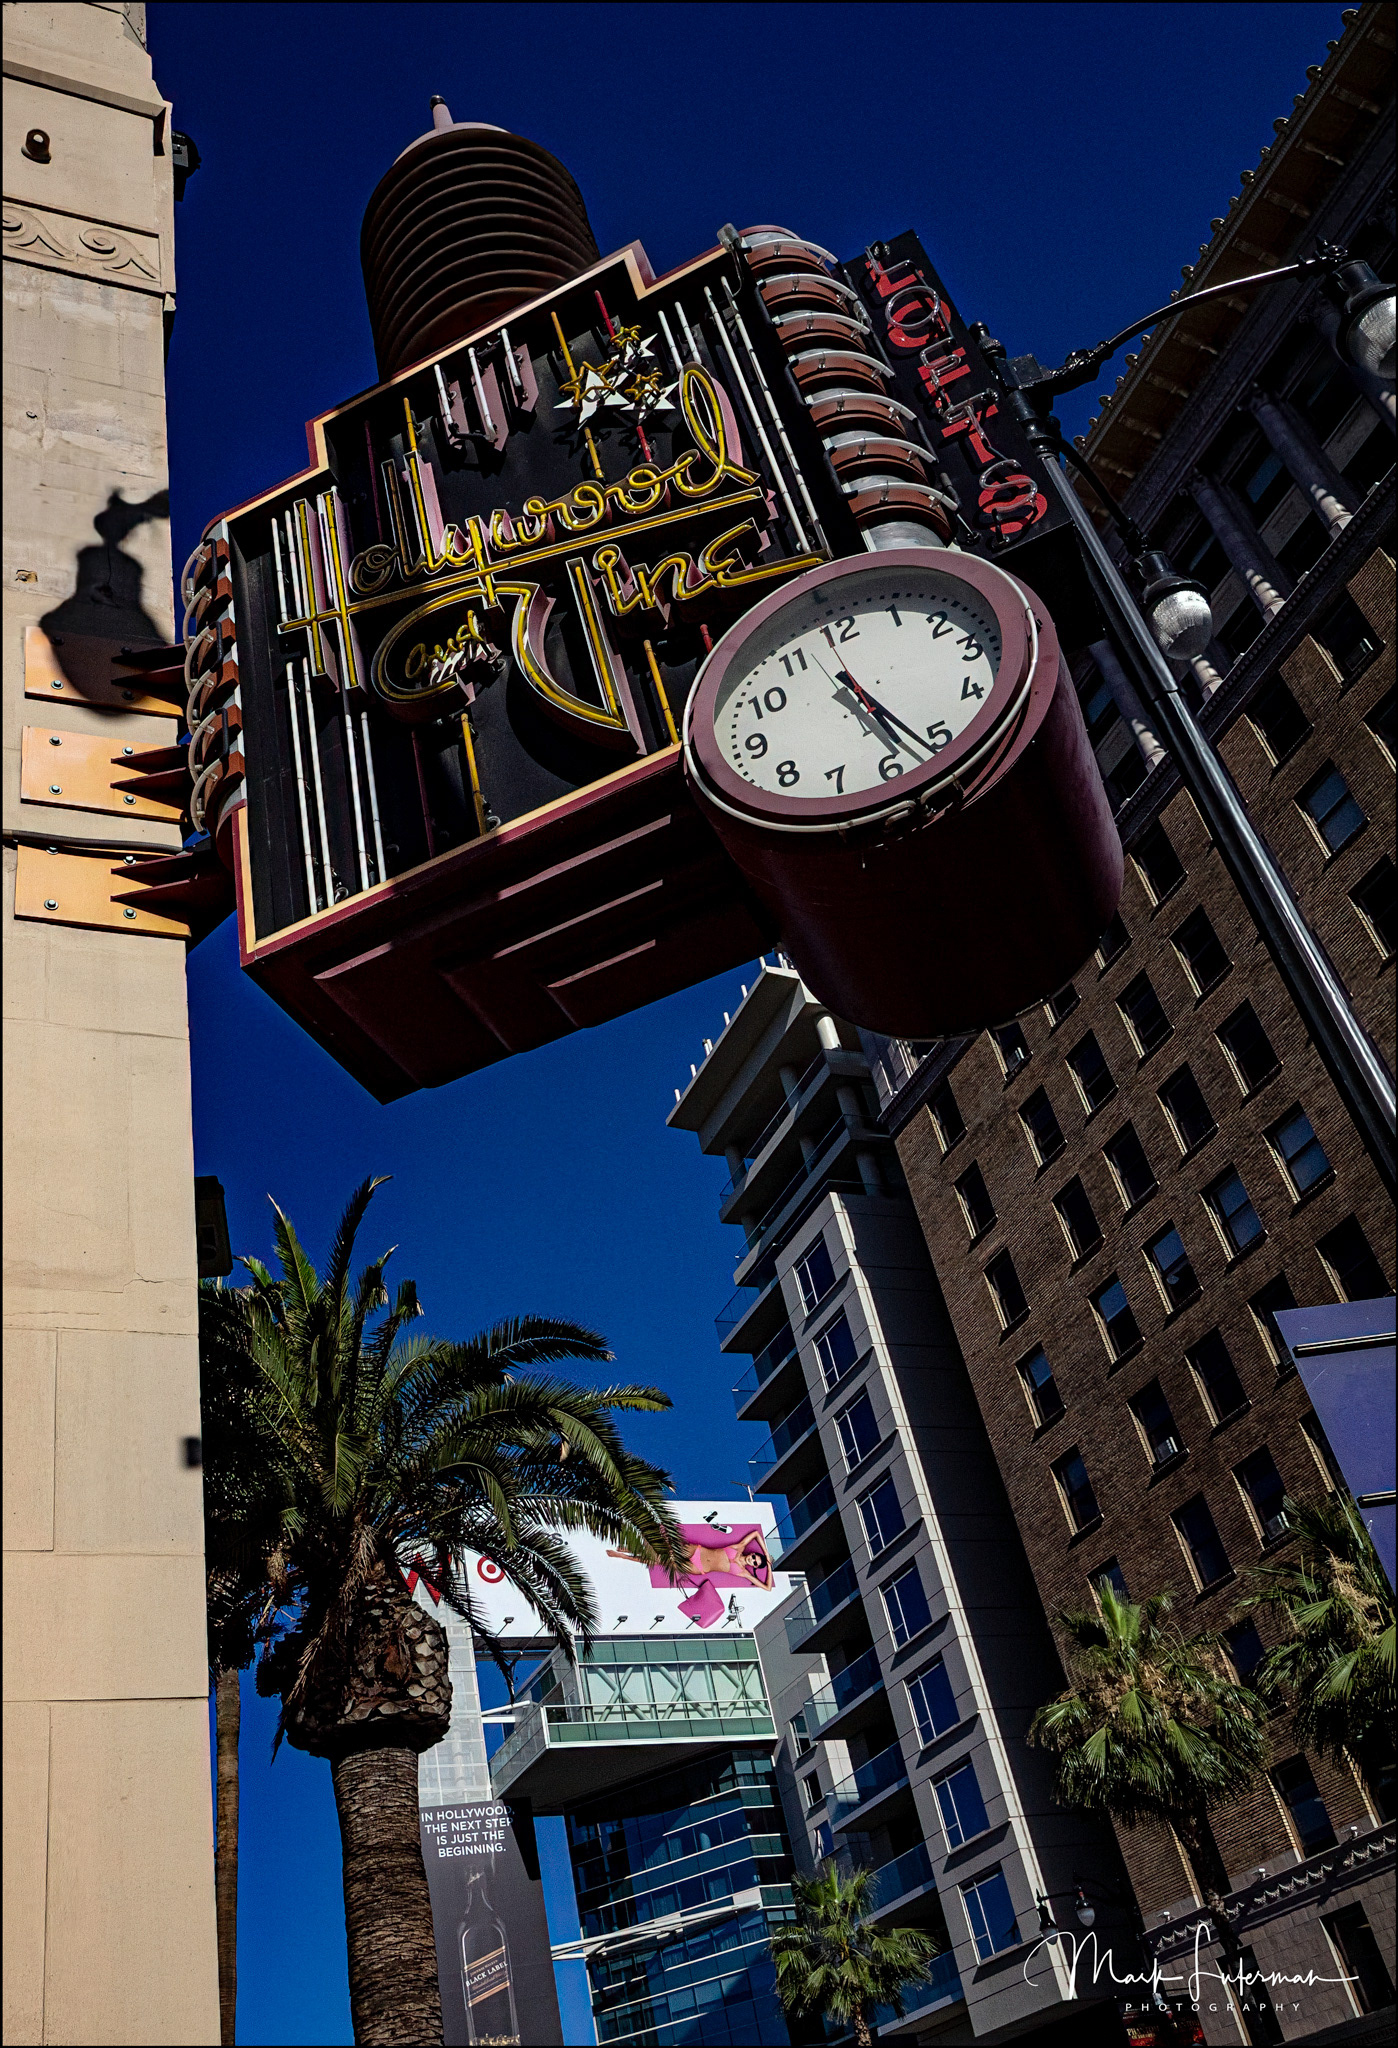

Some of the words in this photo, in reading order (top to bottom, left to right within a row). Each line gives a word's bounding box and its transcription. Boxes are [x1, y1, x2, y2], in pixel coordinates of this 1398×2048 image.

[278, 363, 760, 690] Hollywood
[372, 517, 828, 732] Vine
[884, 604, 904, 627] 1
[926, 611, 953, 639] 2
[820, 615, 860, 649] 12
[404, 610, 499, 687] and
[956, 633, 984, 662] 3
[778, 647, 808, 677] 11
[960, 676, 985, 701] 4
[748, 686, 787, 720] 10
[745, 733, 768, 759] 9
[926, 720, 953, 750] 5
[775, 760, 800, 788] 8
[824, 765, 847, 794] 7
[878, 753, 904, 782] 6
[421, 1812, 433, 1822] IN
[424, 1823, 448, 1834] THE
[451, 1820, 482, 1831] NEXT
[436, 1836, 447, 1845] IS
[451, 1832, 478, 1844] JUST
[482, 1830, 505, 1841] THE
[438, 1843, 506, 1858] BEGINNING.
[465, 1971, 487, 1987] BLACK
[487, 1961, 508, 1975] LABEL
